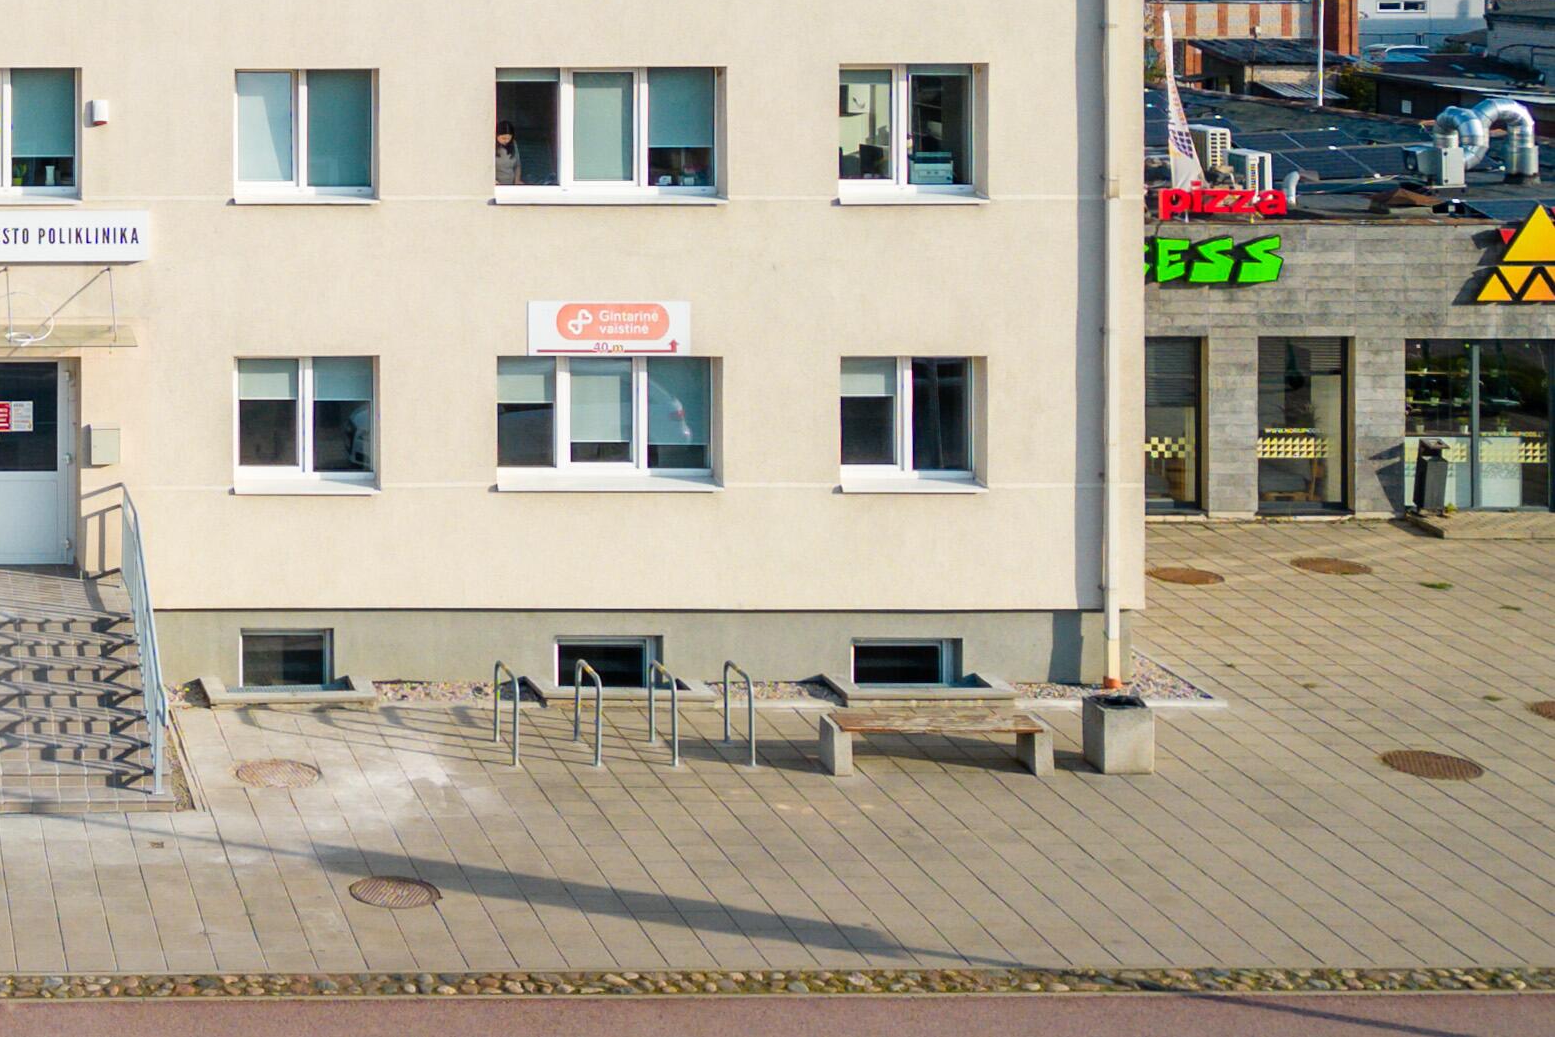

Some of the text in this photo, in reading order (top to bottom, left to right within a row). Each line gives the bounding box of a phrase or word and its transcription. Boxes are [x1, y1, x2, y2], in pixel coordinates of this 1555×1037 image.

[1158, 180, 1287, 221] pizza
[38, 227, 139, 245] POLIKLINIKA
[1144, 235, 1284, 283] ESS
[593, 342, 624, 353] 40 m
